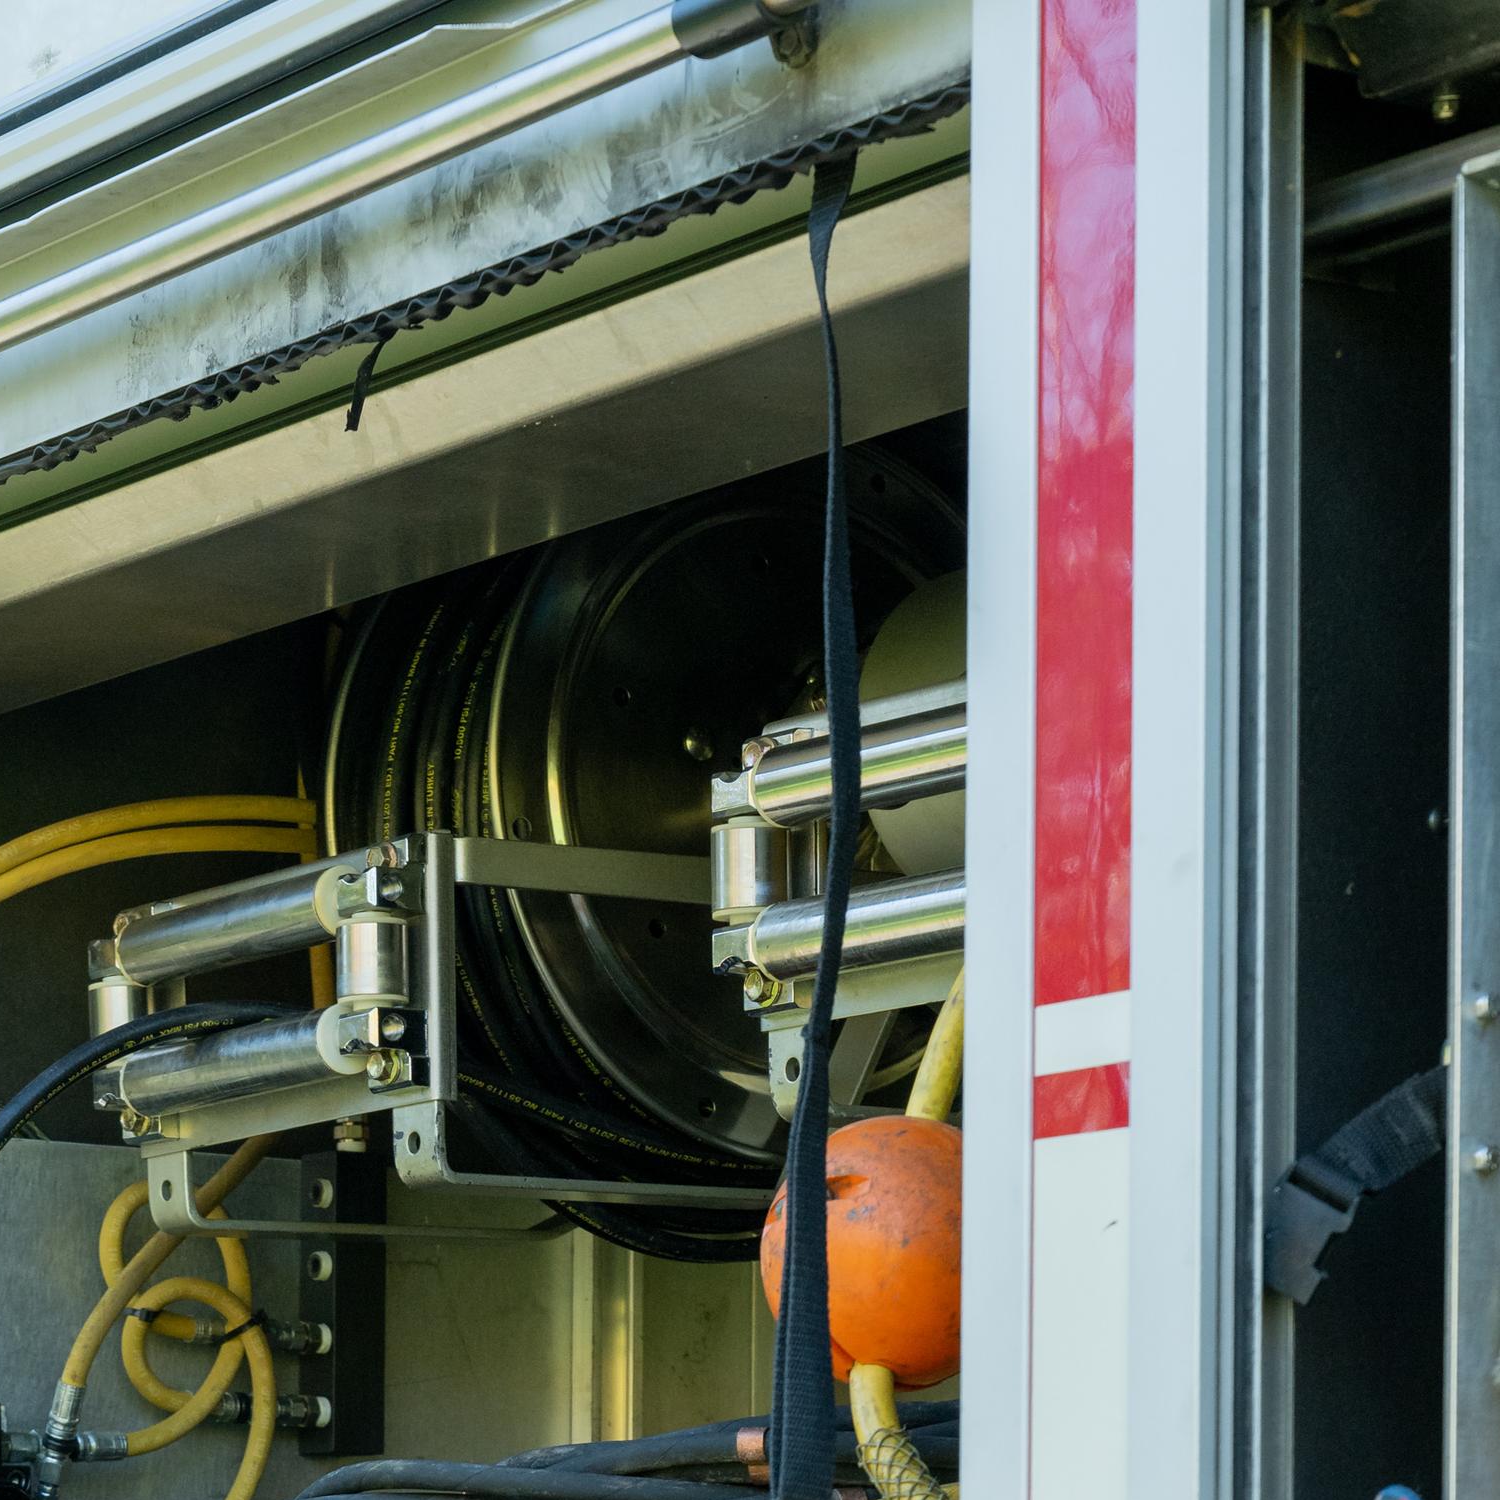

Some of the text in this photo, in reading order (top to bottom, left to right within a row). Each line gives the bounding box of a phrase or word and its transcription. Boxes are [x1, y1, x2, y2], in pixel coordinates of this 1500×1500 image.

[426, 760, 435, 806] TURKEY
[427, 806, 433, 818] IN
[540, 1107, 565, 1121] PART
